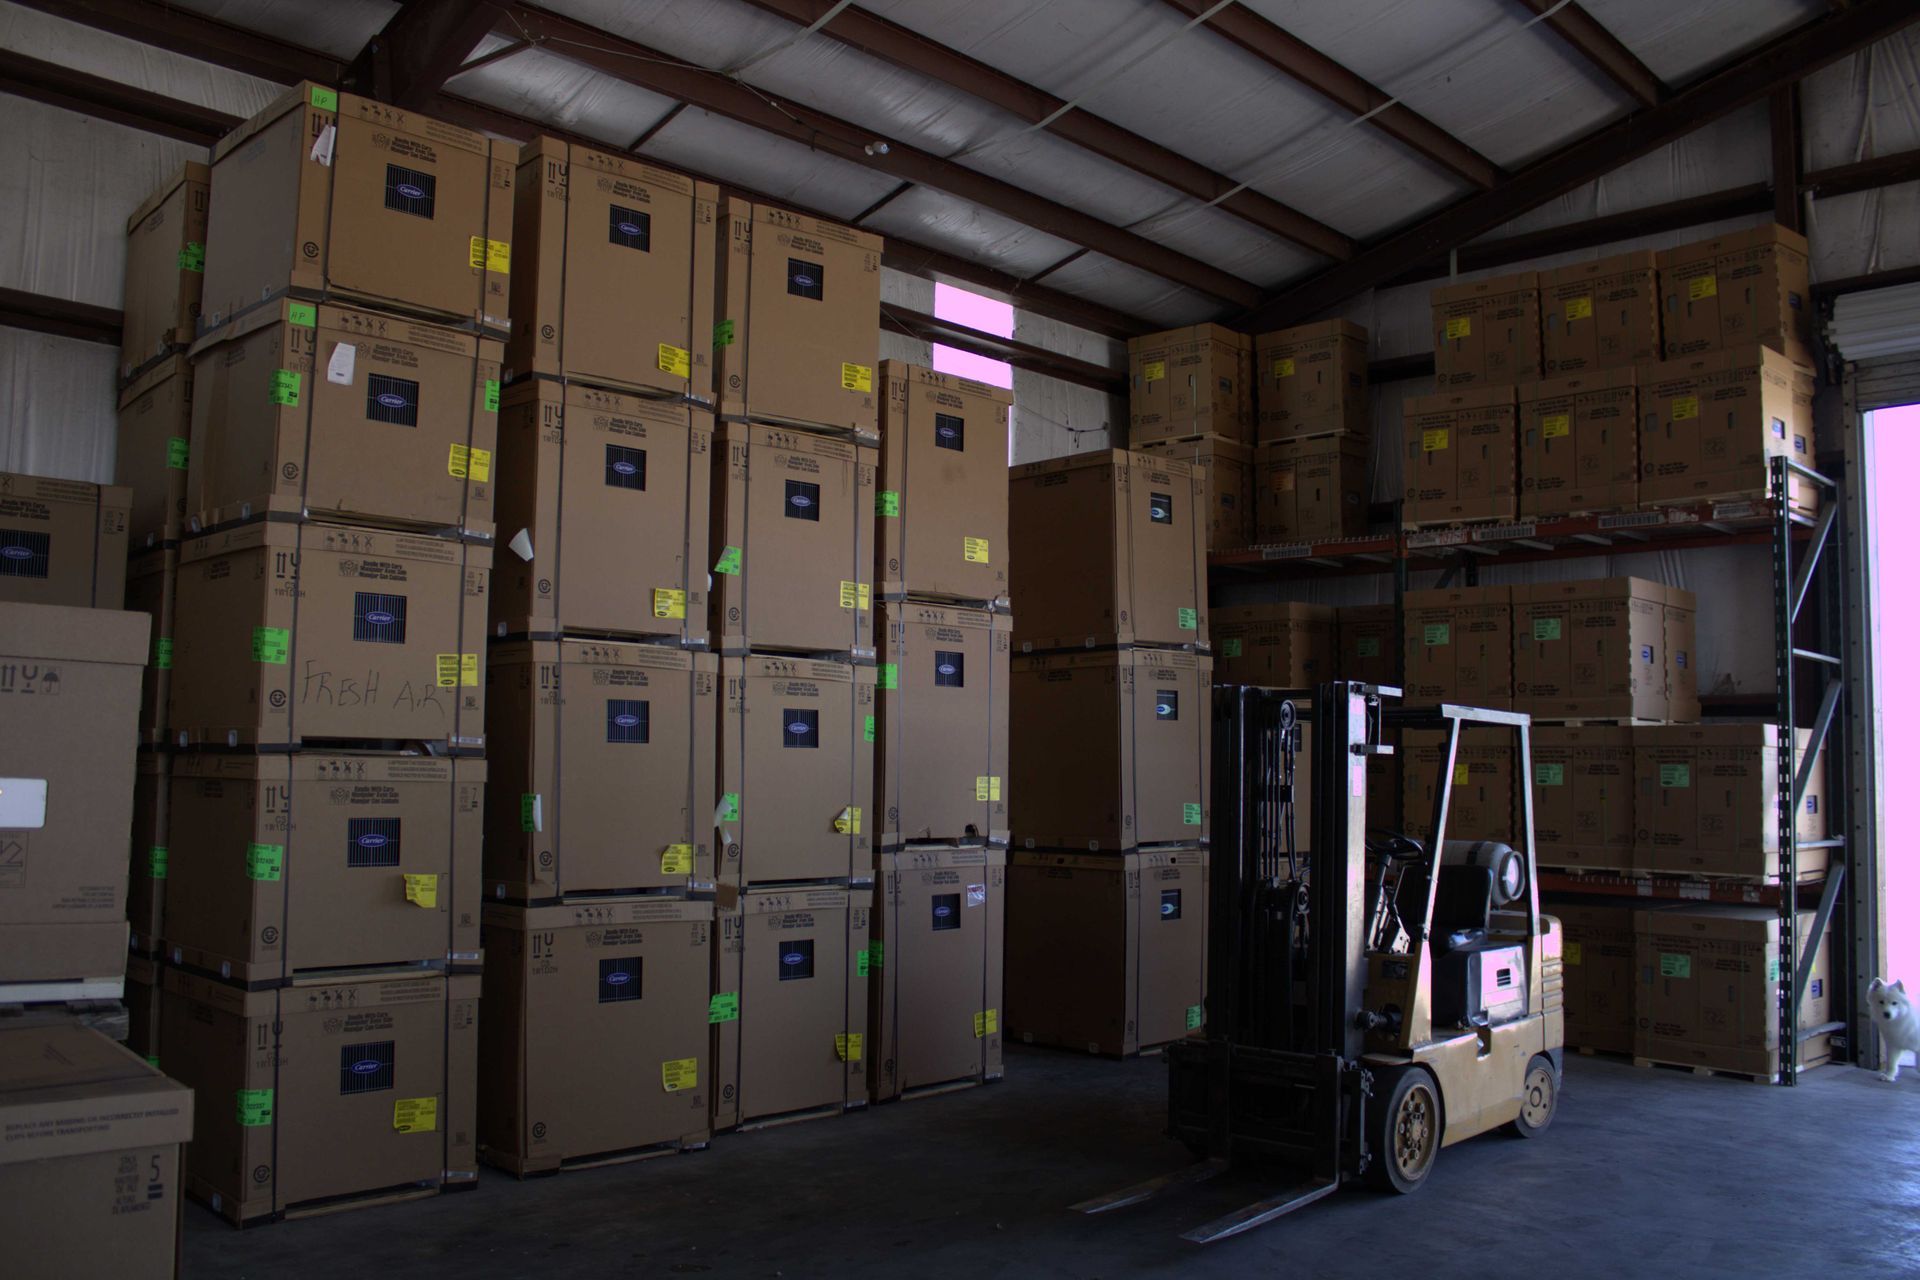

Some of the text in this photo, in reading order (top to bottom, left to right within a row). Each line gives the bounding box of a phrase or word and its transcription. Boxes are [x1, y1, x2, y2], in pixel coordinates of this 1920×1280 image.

[398, 185, 422, 197] Carrier
[379, 396, 404, 406] Carrier
[4, 548, 30, 558] Carrier
[367, 612, 391, 623] Carrier
[302, 659, 380, 706] FRESH
[360, 836, 385, 846] Carrier
[354, 1062, 378, 1072] Carrier
[150, 1154, 160, 1182] 5
